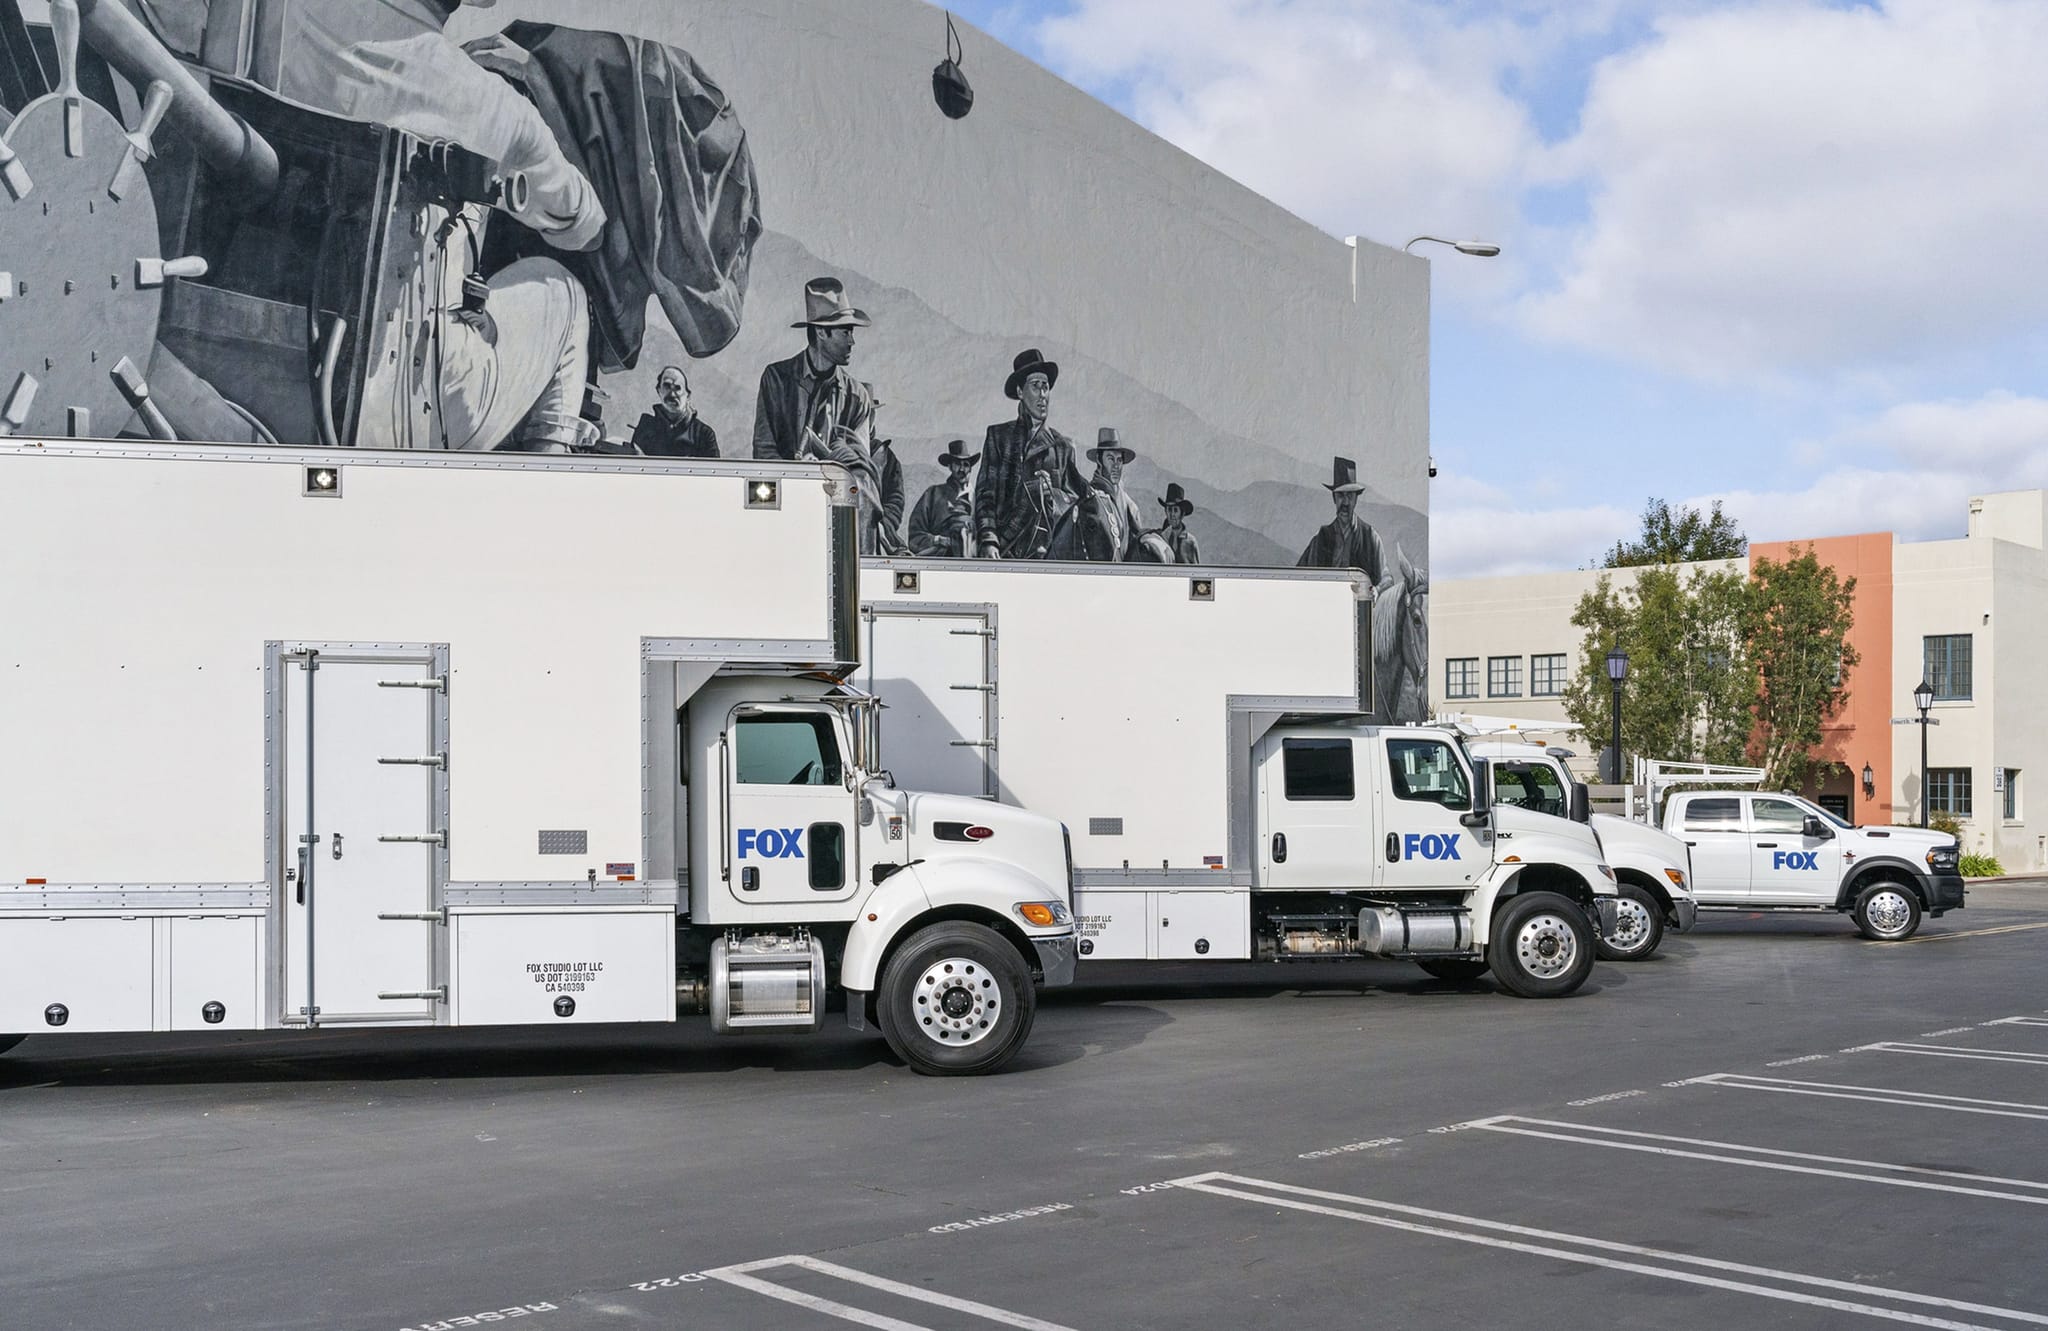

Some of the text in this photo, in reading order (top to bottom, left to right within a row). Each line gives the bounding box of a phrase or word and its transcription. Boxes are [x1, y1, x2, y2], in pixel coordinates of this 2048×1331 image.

[737, 828, 805, 859] FOX
[1404, 833, 1461, 861] FOX
[1773, 851, 1819, 870] FOX
[526, 962, 603, 973] FOX STUDIO LOT LLC
[534, 972, 595, 982] US DOT 3199163
[545, 982, 585, 992] CA 540398
[928, 1201, 1075, 1234] RESERVED
[399, 1271, 707, 1331] D22 RESER
